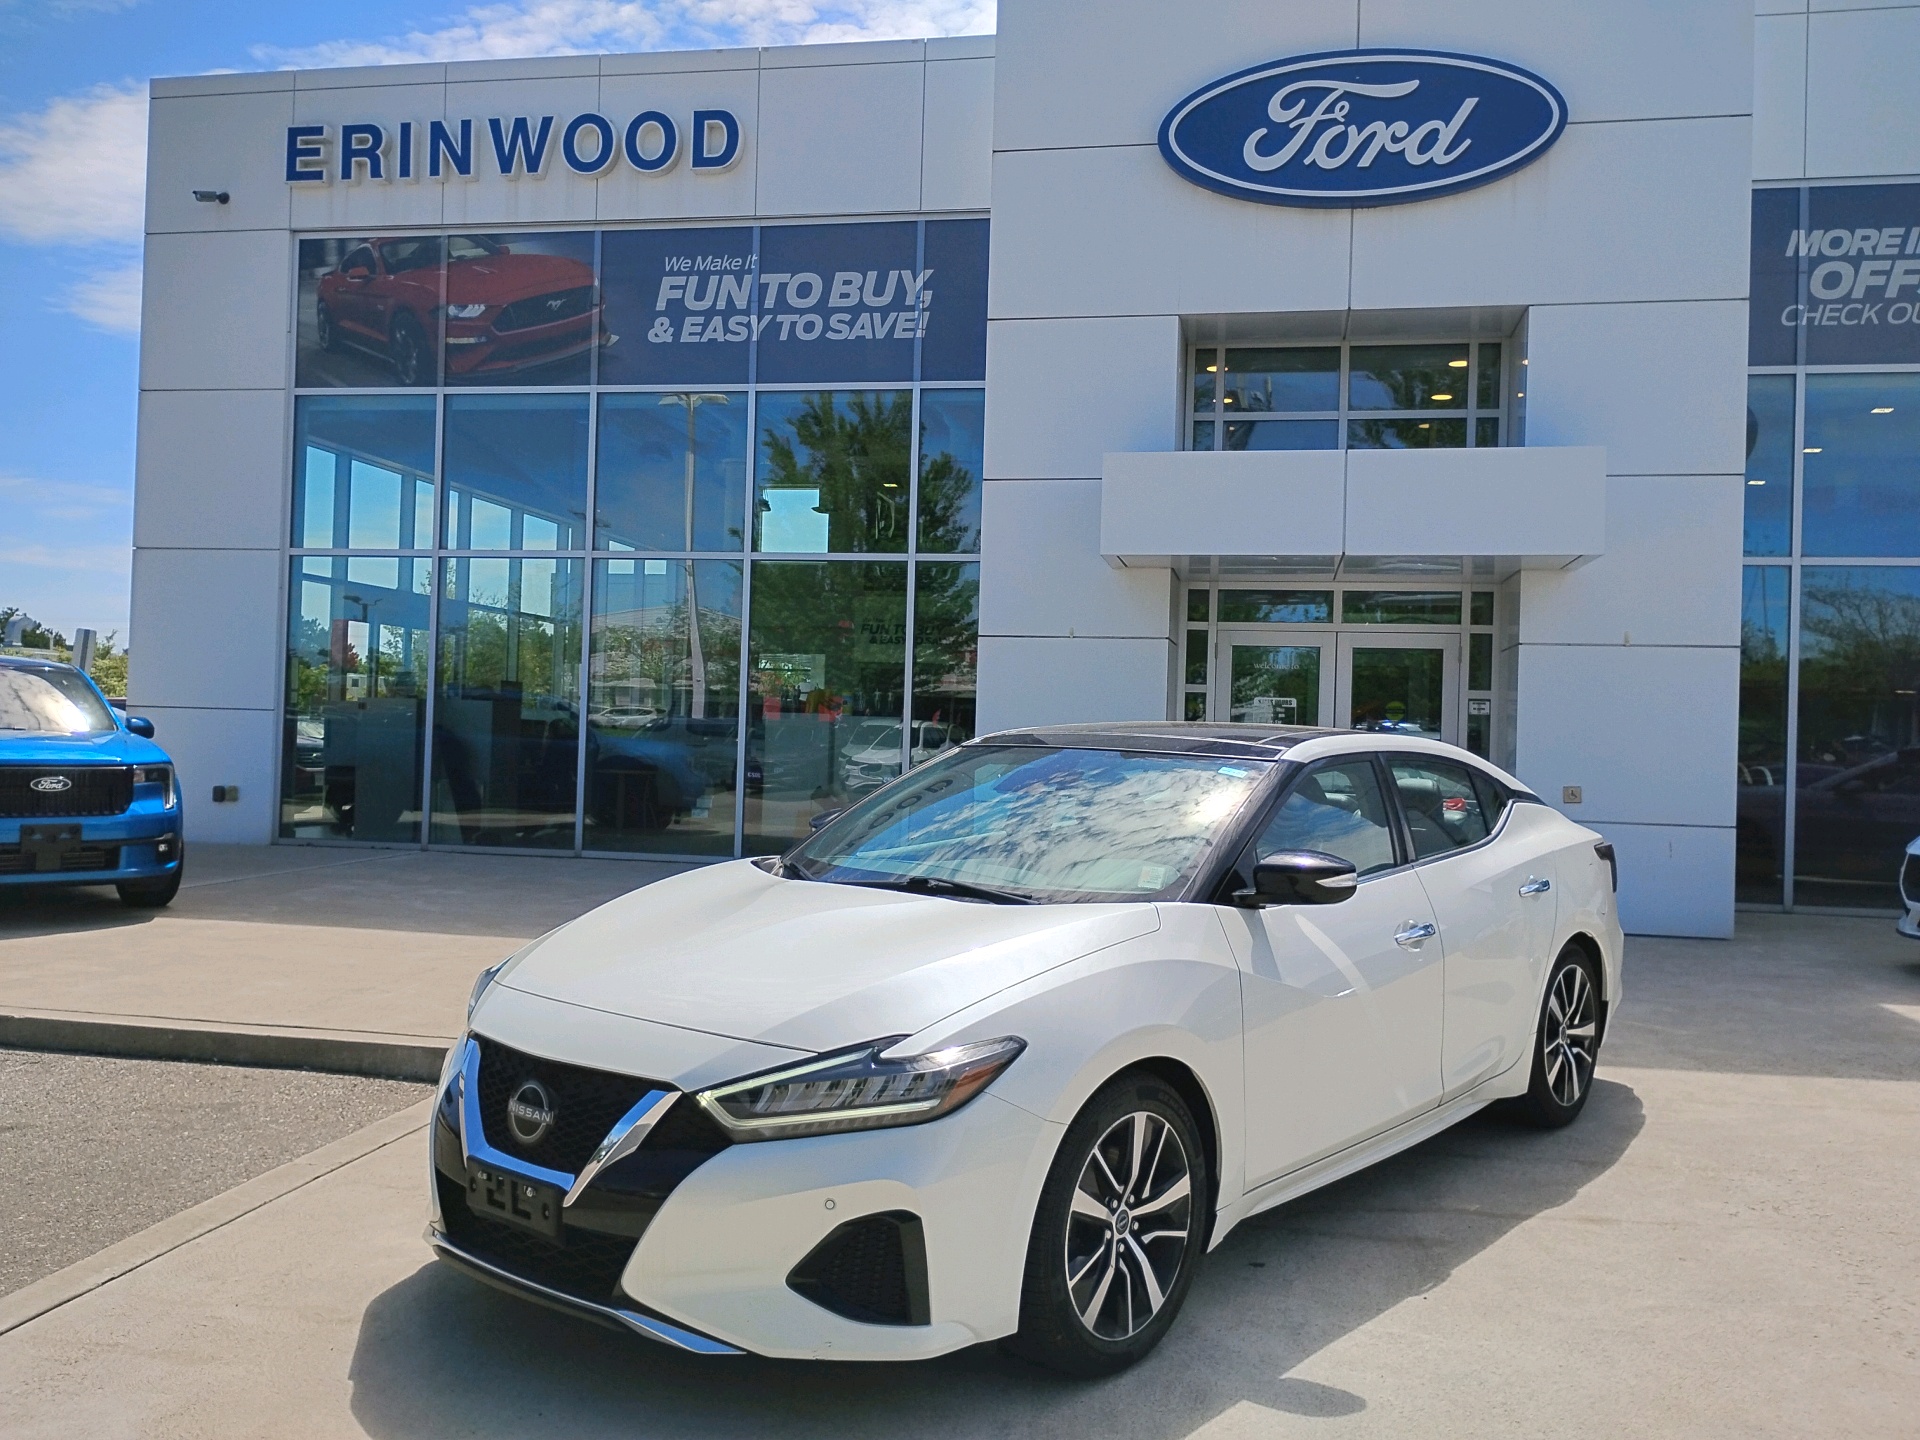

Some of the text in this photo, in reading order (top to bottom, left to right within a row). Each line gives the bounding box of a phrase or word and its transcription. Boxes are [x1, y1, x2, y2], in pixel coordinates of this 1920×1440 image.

[1243, 79, 1480, 172] Ford
[285, 108, 743, 183] ERINWOOD
[1785, 227, 1906, 257] MORE
[664, 254, 758, 272] We Make It
[655, 274, 754, 311] FUN
[759, 272, 824, 309] TO
[1809, 259, 1920, 300] OFF
[647, 311, 930, 343] & EASY TO SAVE!
[1780, 303, 1883, 327] CHECK
[38, 779, 64, 789] Ford
[508, 1100, 551, 1122] NISSAN
